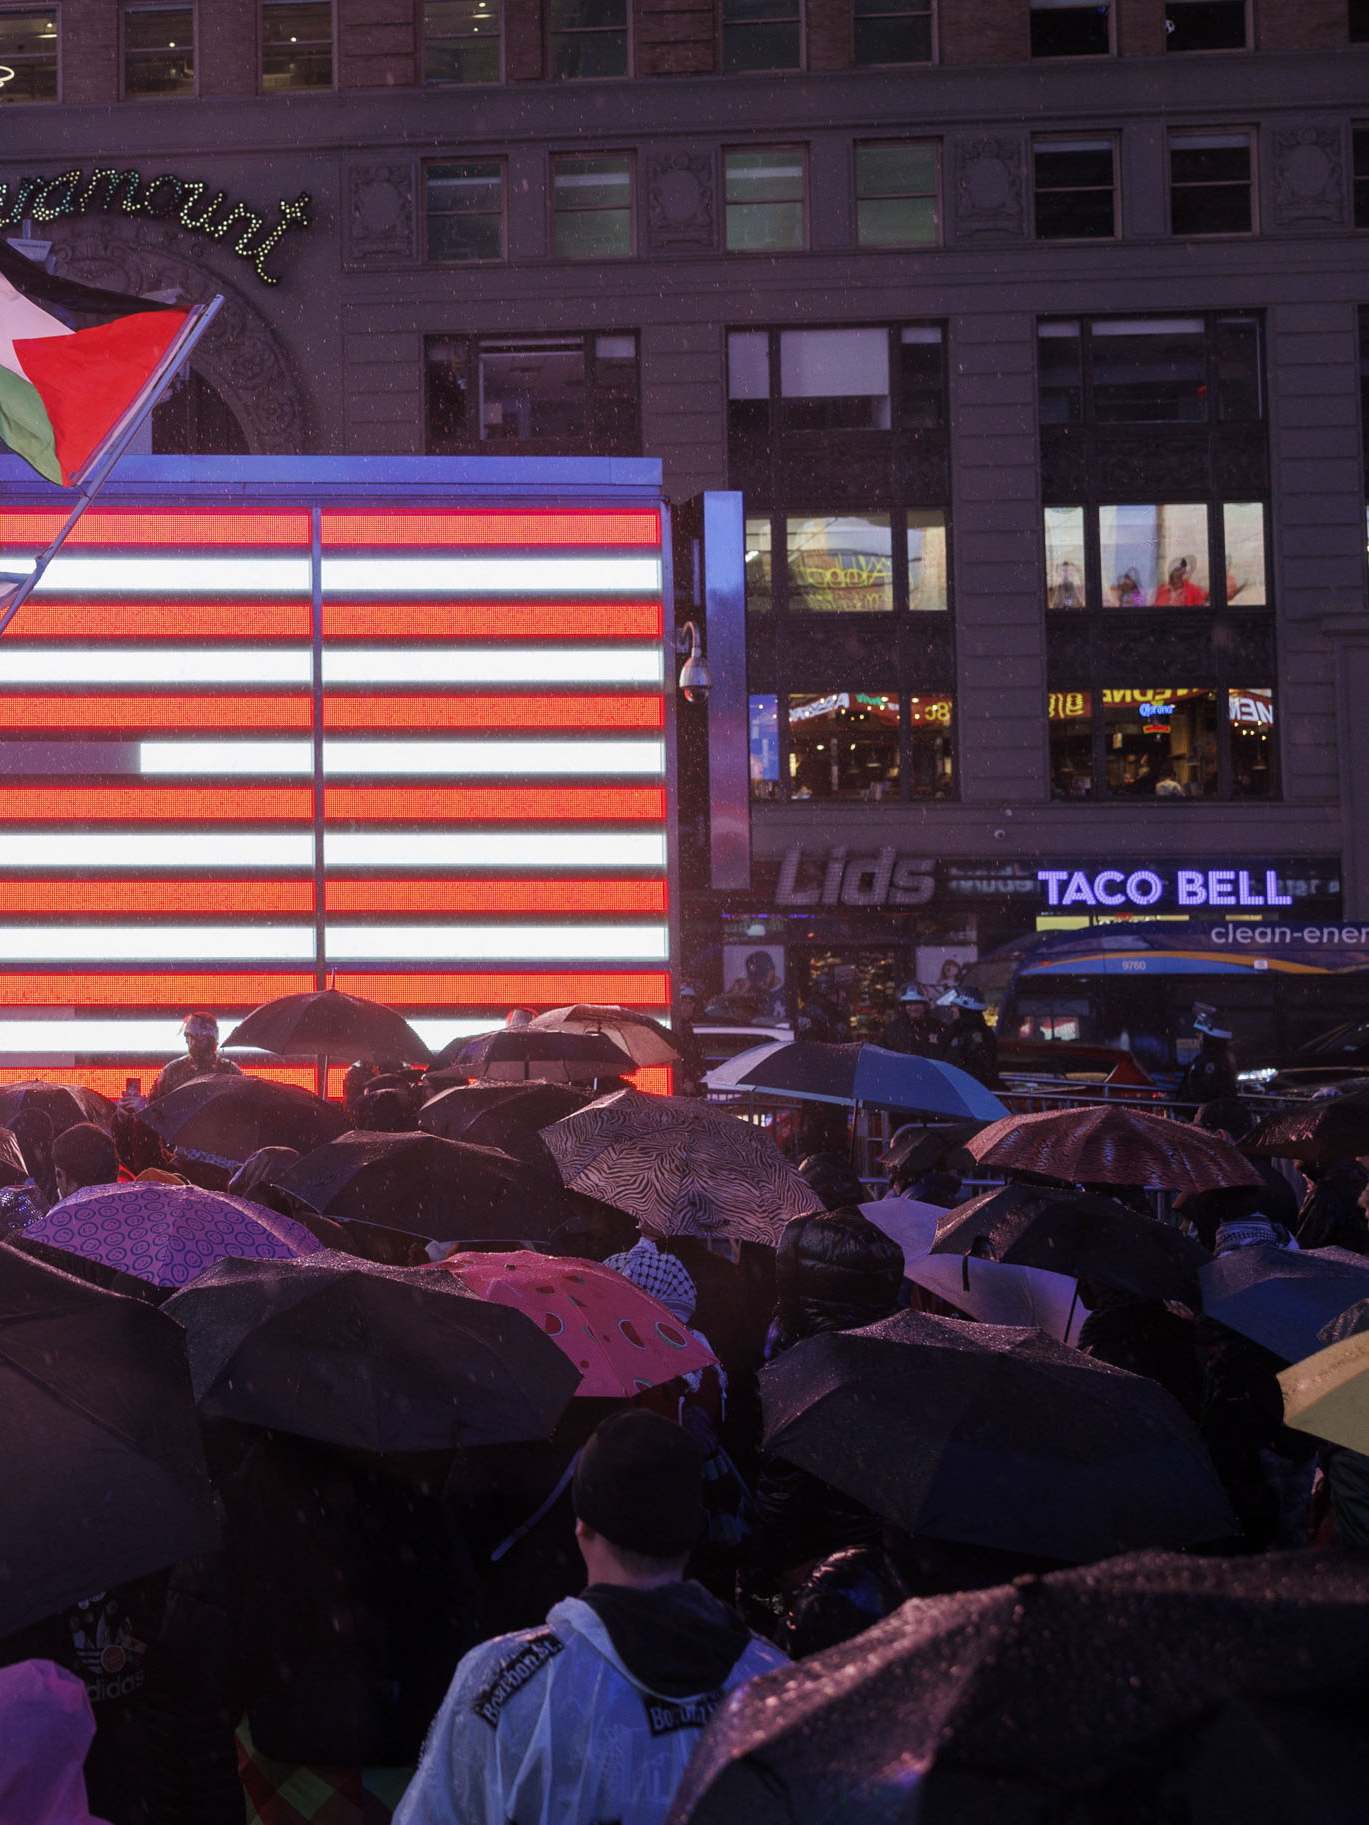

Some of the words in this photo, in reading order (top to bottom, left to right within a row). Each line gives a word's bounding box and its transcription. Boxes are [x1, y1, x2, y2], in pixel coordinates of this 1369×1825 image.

[773, 845, 937, 906] Lids
[1037, 869, 1164, 907] TACO
[1177, 869, 1293, 907] BELL
[1210, 923, 1369, 945] clean-ener
[1122, 960, 1146, 971] 9760
[86, 1669, 144, 1703] didas
